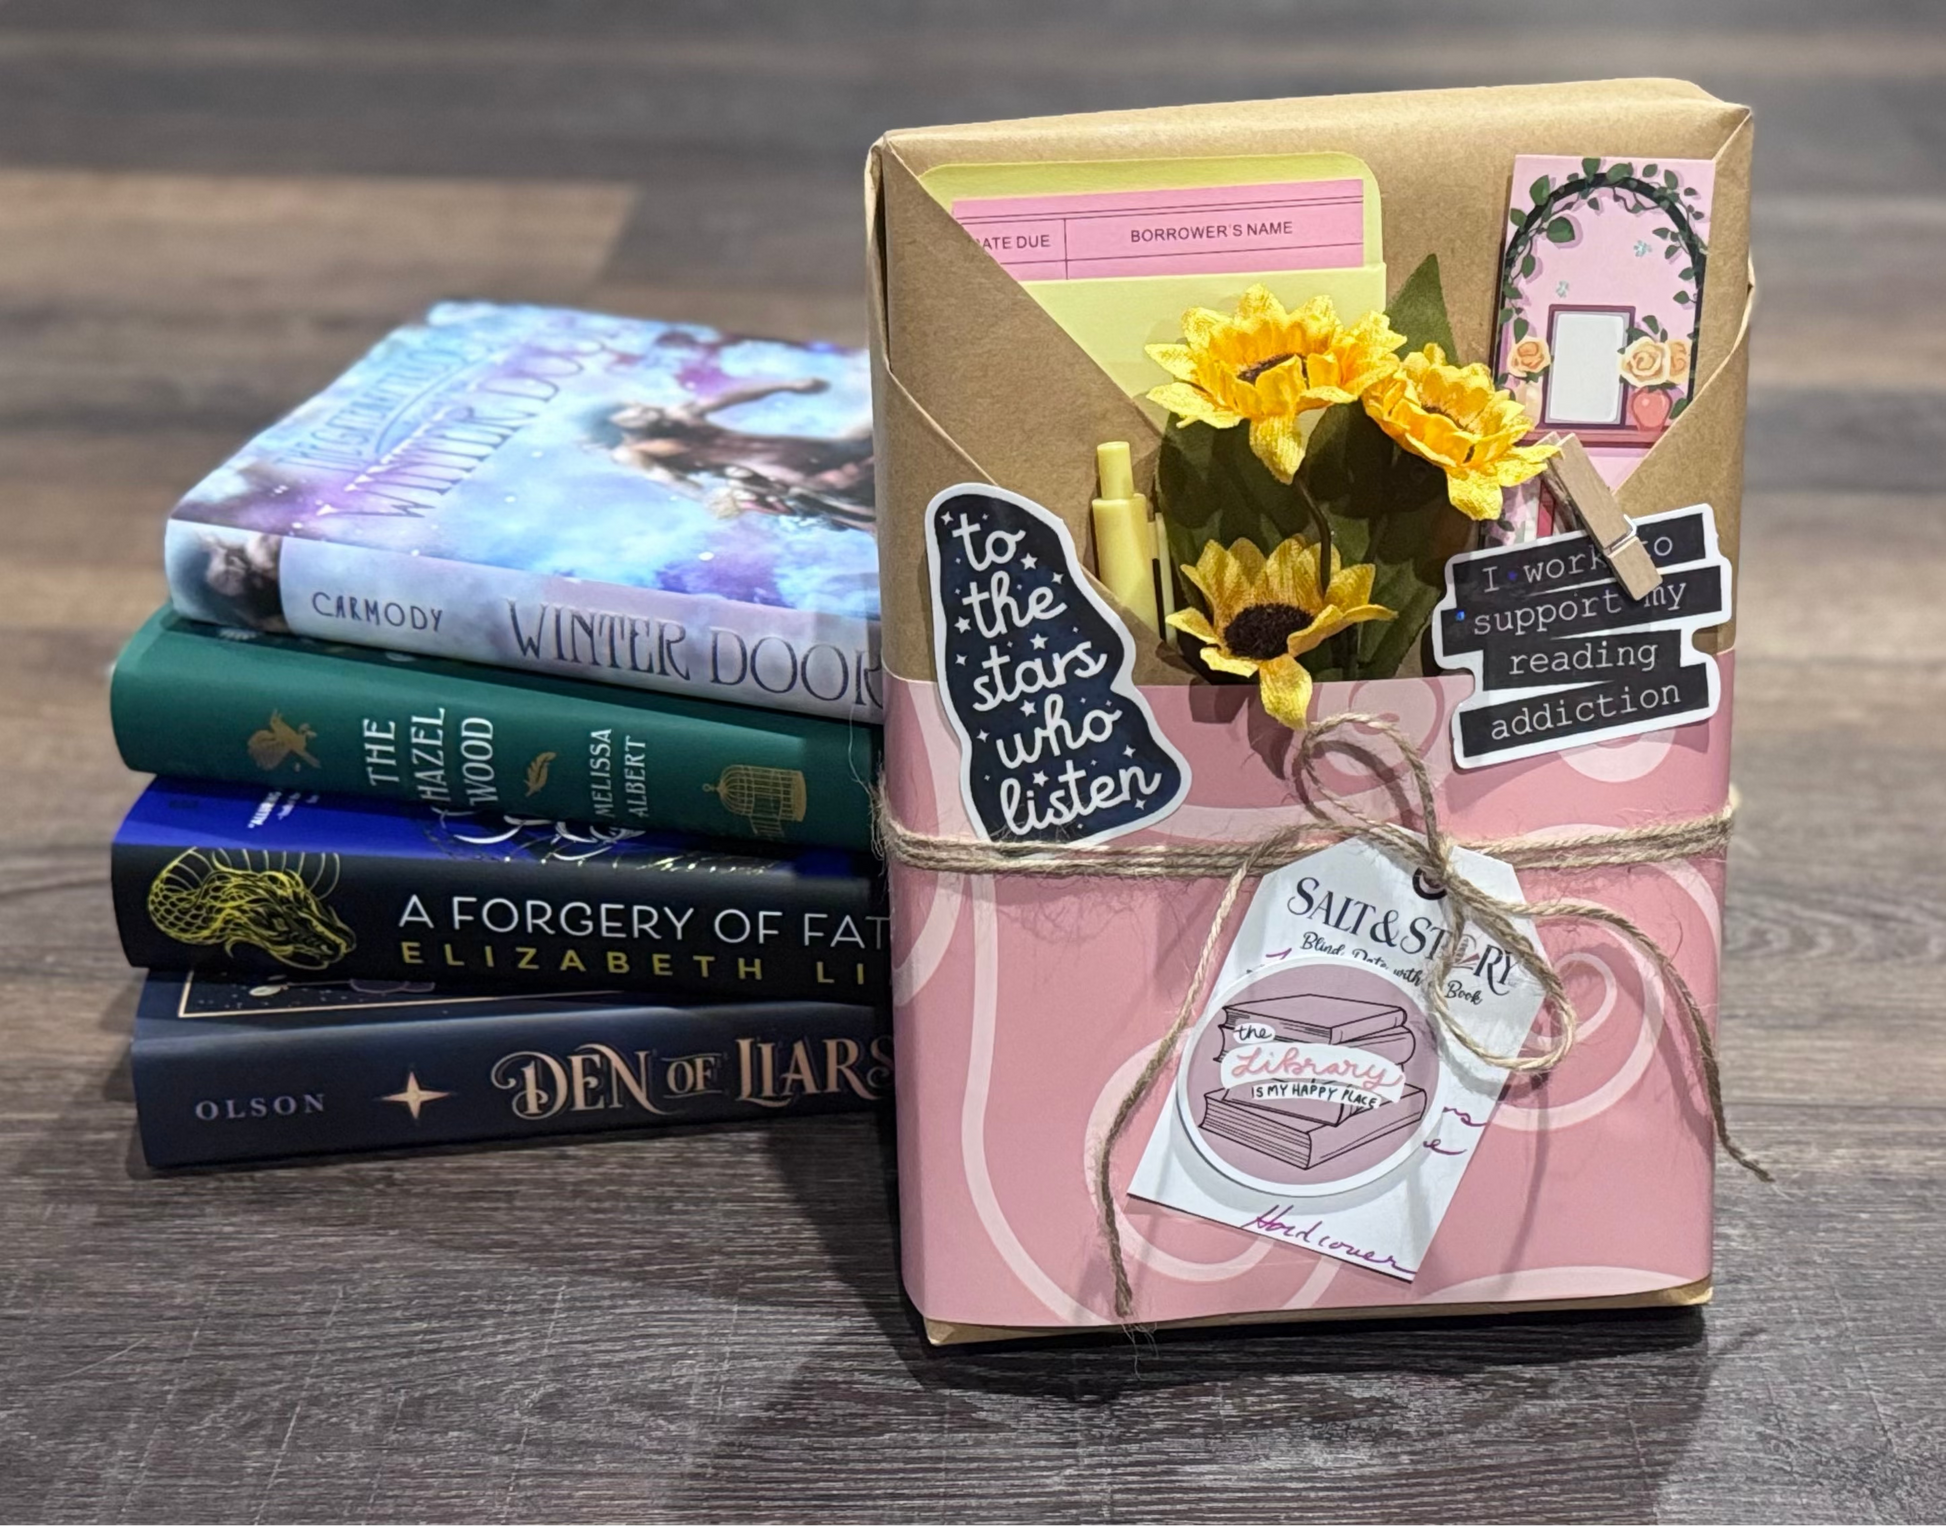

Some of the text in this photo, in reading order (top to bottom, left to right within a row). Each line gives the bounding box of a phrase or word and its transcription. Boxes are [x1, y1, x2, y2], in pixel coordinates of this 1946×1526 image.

[975, 234, 1051, 250] ATE DUE
[1130, 221, 1293, 243] BORROWER'S NAME
[952, 513, 1026, 572] to
[1482, 536, 1673, 593] I work o
[962, 570, 1068, 639] the
[1473, 582, 1687, 635] support my
[311, 591, 883, 710] CARMODY WINTER DOOR
[972, 641, 1107, 712] stars
[1508, 641, 1659, 676] reading
[996, 693, 1123, 769] who
[1491, 684, 1682, 741] addiction
[363, 718, 400, 787] THE
[410, 707, 451, 803] HAZEL
[460, 716, 499, 806] WOOD
[589, 728, 615, 819] MELISSA
[625, 735, 649, 819] ALBERT
[1000, 759, 1162, 836] listen
[399, 894, 890, 950] A FORGERY OF FAT
[400, 941, 865, 985] ELIZABETH LI
[1300, 931, 1346, 956] Blind
[1393, 967, 1423, 987] with
[1444, 979, 1484, 1006] Book
[1235, 1023, 1273, 1041] the
[195, 1034, 894, 1121] OLSON DEN OF LIARS
[1231, 1046, 1405, 1090] Library
[1251, 1083, 1378, 1107] IS MY HAPPY PLACE
